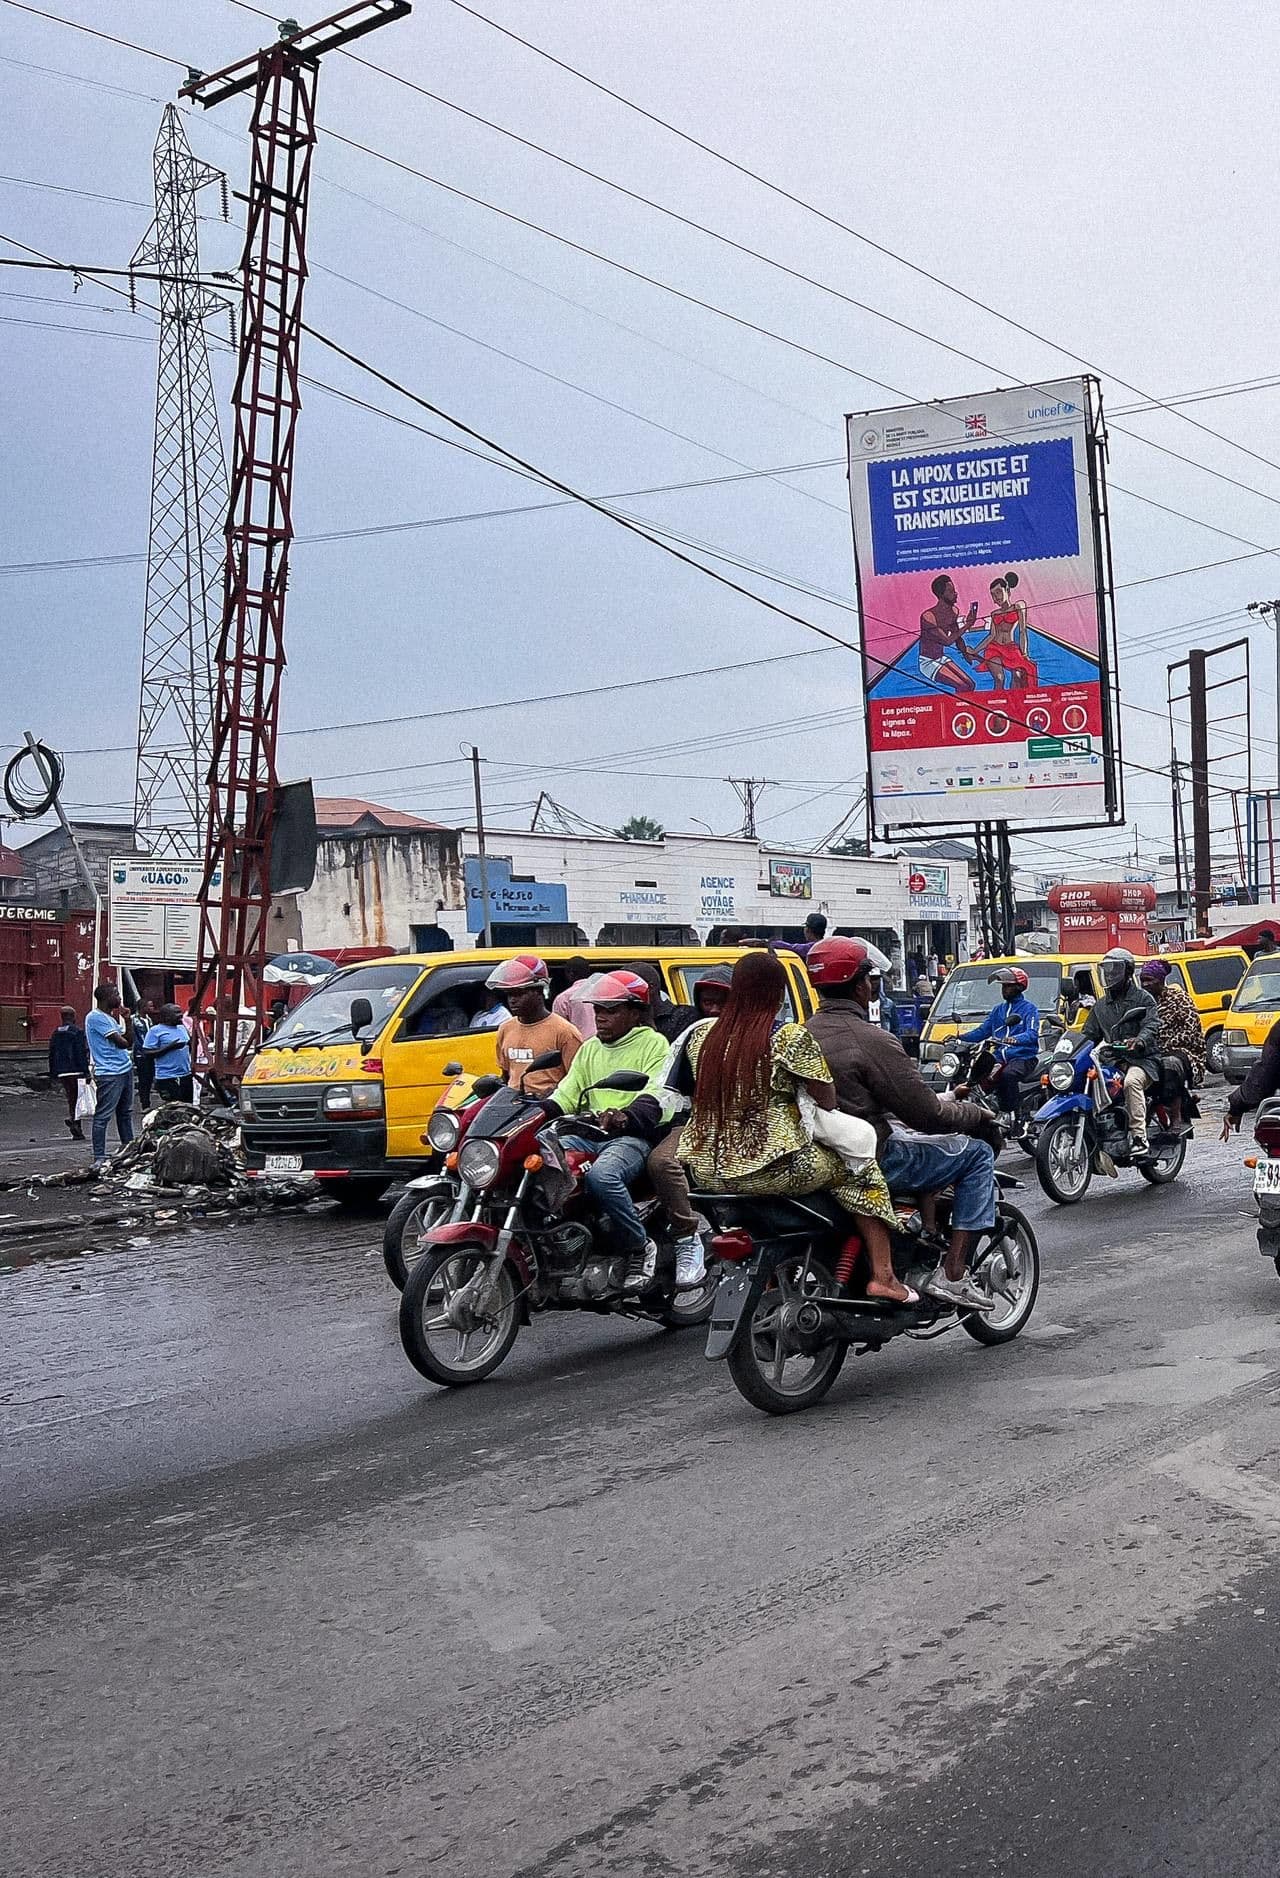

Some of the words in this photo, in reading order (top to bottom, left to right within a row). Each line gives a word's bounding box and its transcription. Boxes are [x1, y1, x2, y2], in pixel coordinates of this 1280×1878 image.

[1027, 402, 1062, 419] unicef
[891, 469, 910, 488] LA
[913, 463, 954, 485] MPOX
[956, 457, 1008, 481] EXISTE
[1010, 454, 1029, 474] ET
[892, 490, 919, 510] EST
[922, 477, 1030, 507] SEXUELLEMENT
[894, 503, 1005, 532] TRANSMISSIBLE.
[700, 876, 735, 889] AGENCE
[619, 891, 667, 905] PHARMACIE
[1060, 890, 1091, 901] SHOP
[1122, 888, 1142, 898] SHOP
[701, 895, 735, 908] VOYAGE
[0, 906, 56, 921] JEREMIE
[1120, 913, 1137, 924] SWAP
[1063, 915, 1093, 927] SWAP
